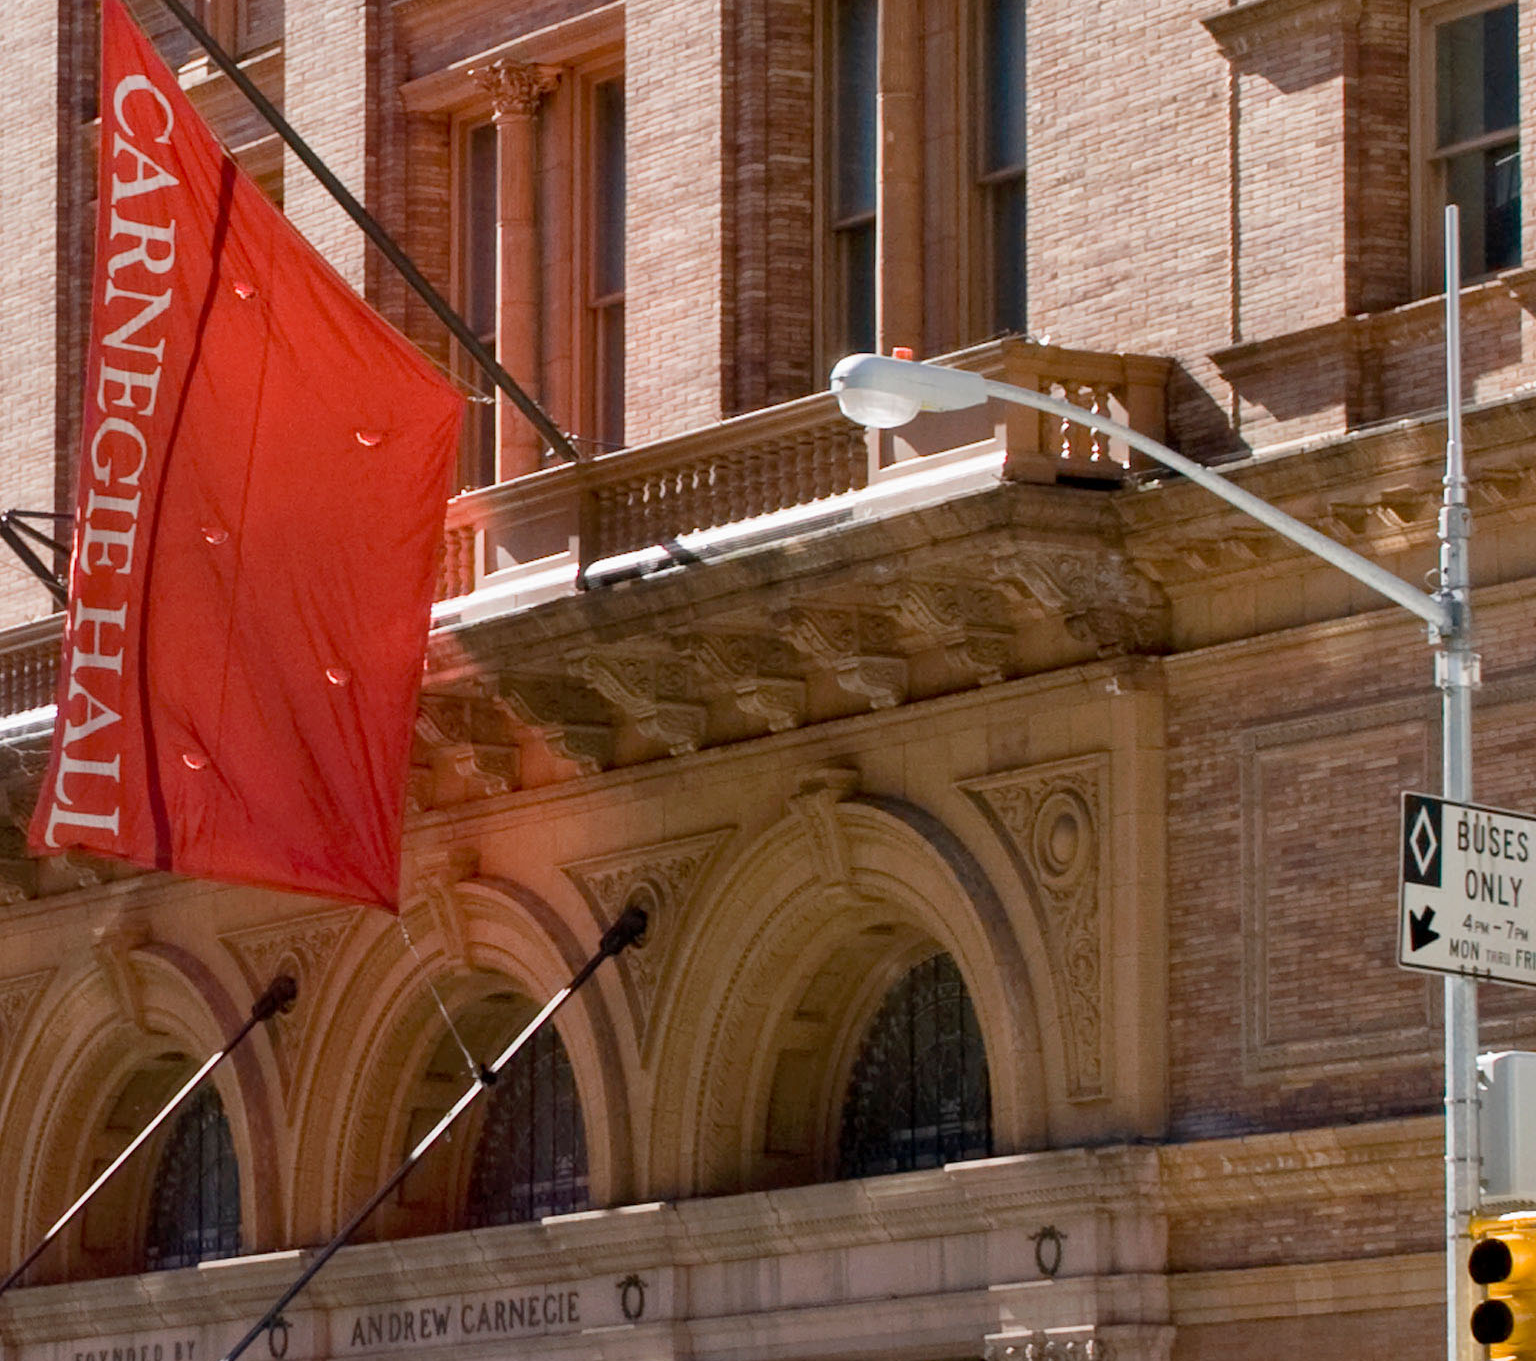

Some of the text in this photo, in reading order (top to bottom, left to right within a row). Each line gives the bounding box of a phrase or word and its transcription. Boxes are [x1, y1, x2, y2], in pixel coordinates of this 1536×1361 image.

[45, 74, 180, 846] CARNEGIE HALL
[1457, 821, 1529, 862] BUSES
[1465, 869, 1522, 908] ONLY
[1449, 938, 1536, 970] MON THRU FRI
[350, 1291, 580, 1347] ANDREW CARNEGIE
[175, 1340, 195, 1361] BY
